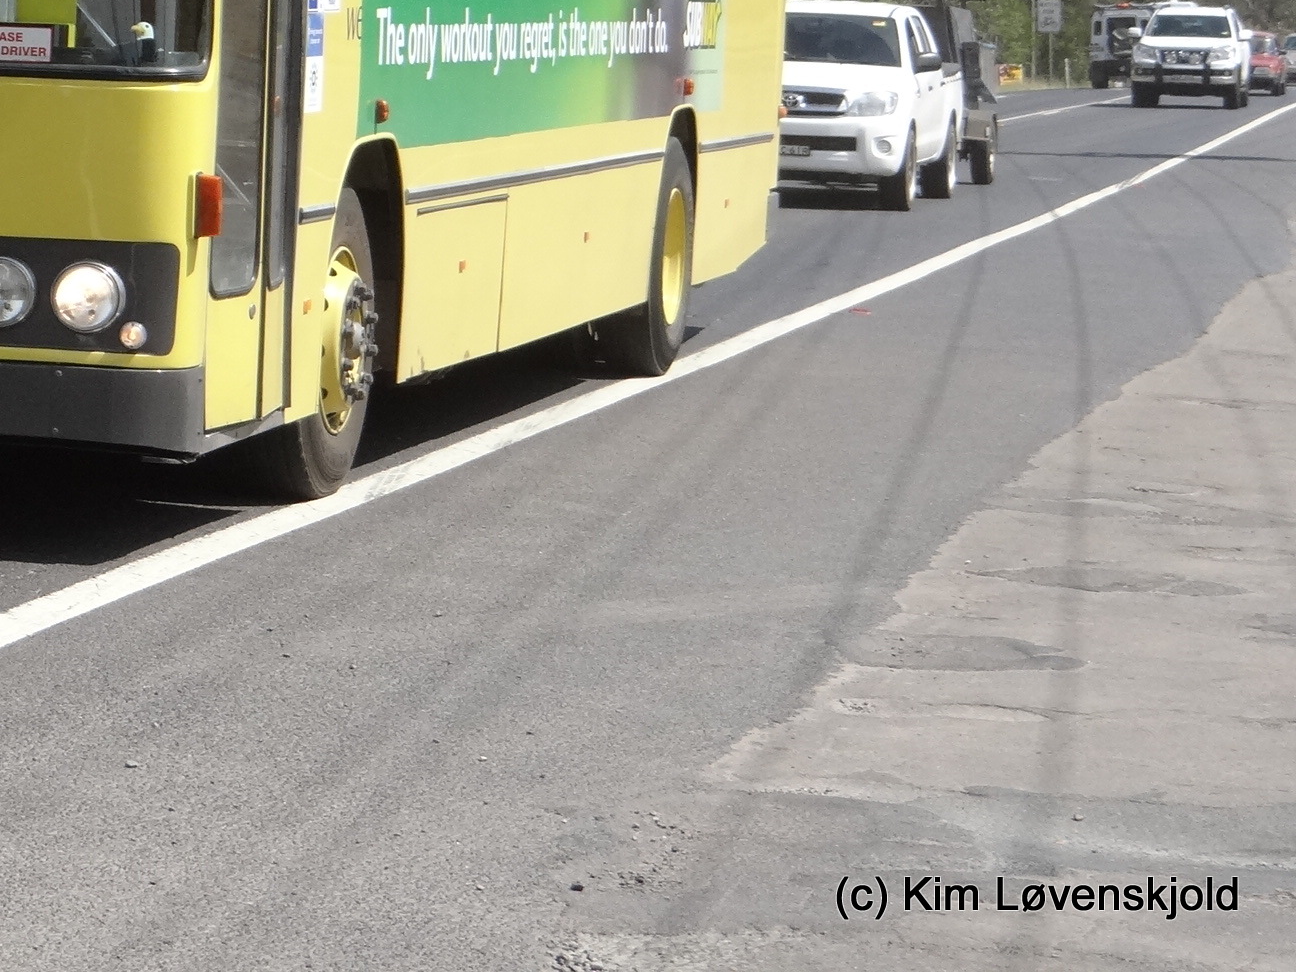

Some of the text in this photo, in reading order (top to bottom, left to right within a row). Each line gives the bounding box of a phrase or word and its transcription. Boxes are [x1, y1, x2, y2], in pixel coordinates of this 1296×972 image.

[0, 46, 47, 57] DRIVER
[376, 6, 669, 80] The only workout you regret, is the one you don't do.
